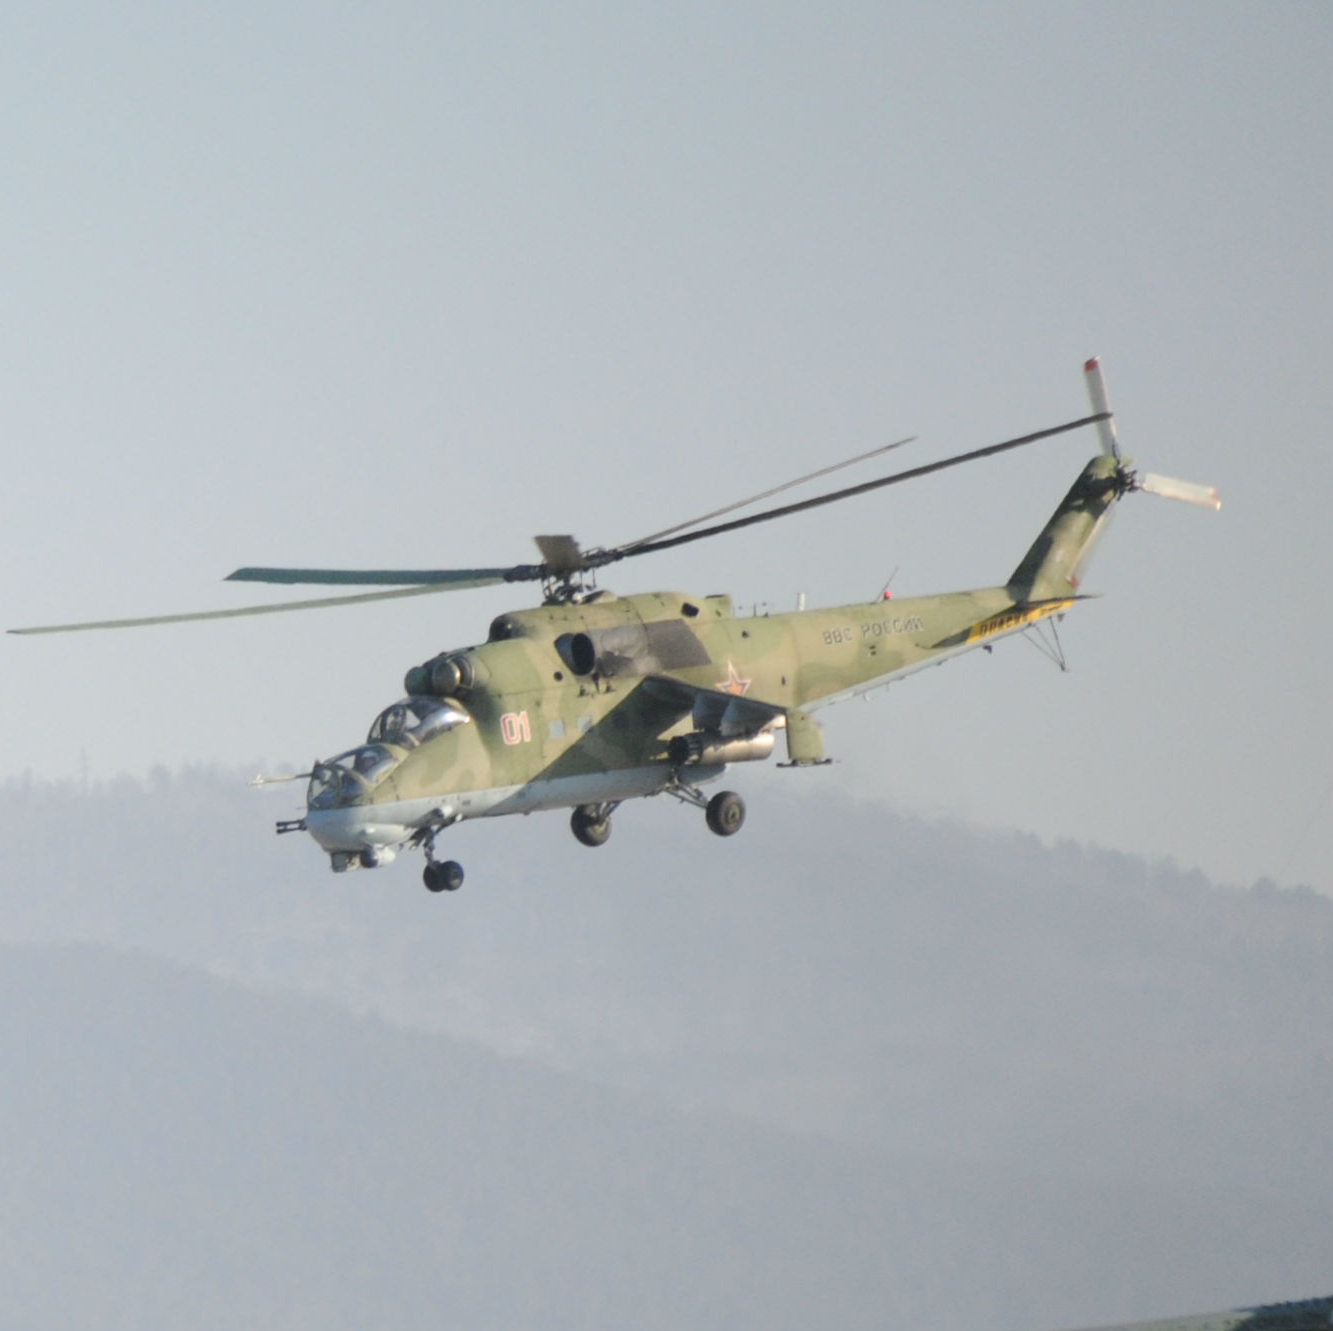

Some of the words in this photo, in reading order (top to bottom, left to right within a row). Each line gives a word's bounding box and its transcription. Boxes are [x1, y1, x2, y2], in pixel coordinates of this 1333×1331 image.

[821, 627, 854, 645] ВВС
[860, 616, 925, 640] РОССИИ
[500, 710, 532, 746] 01
